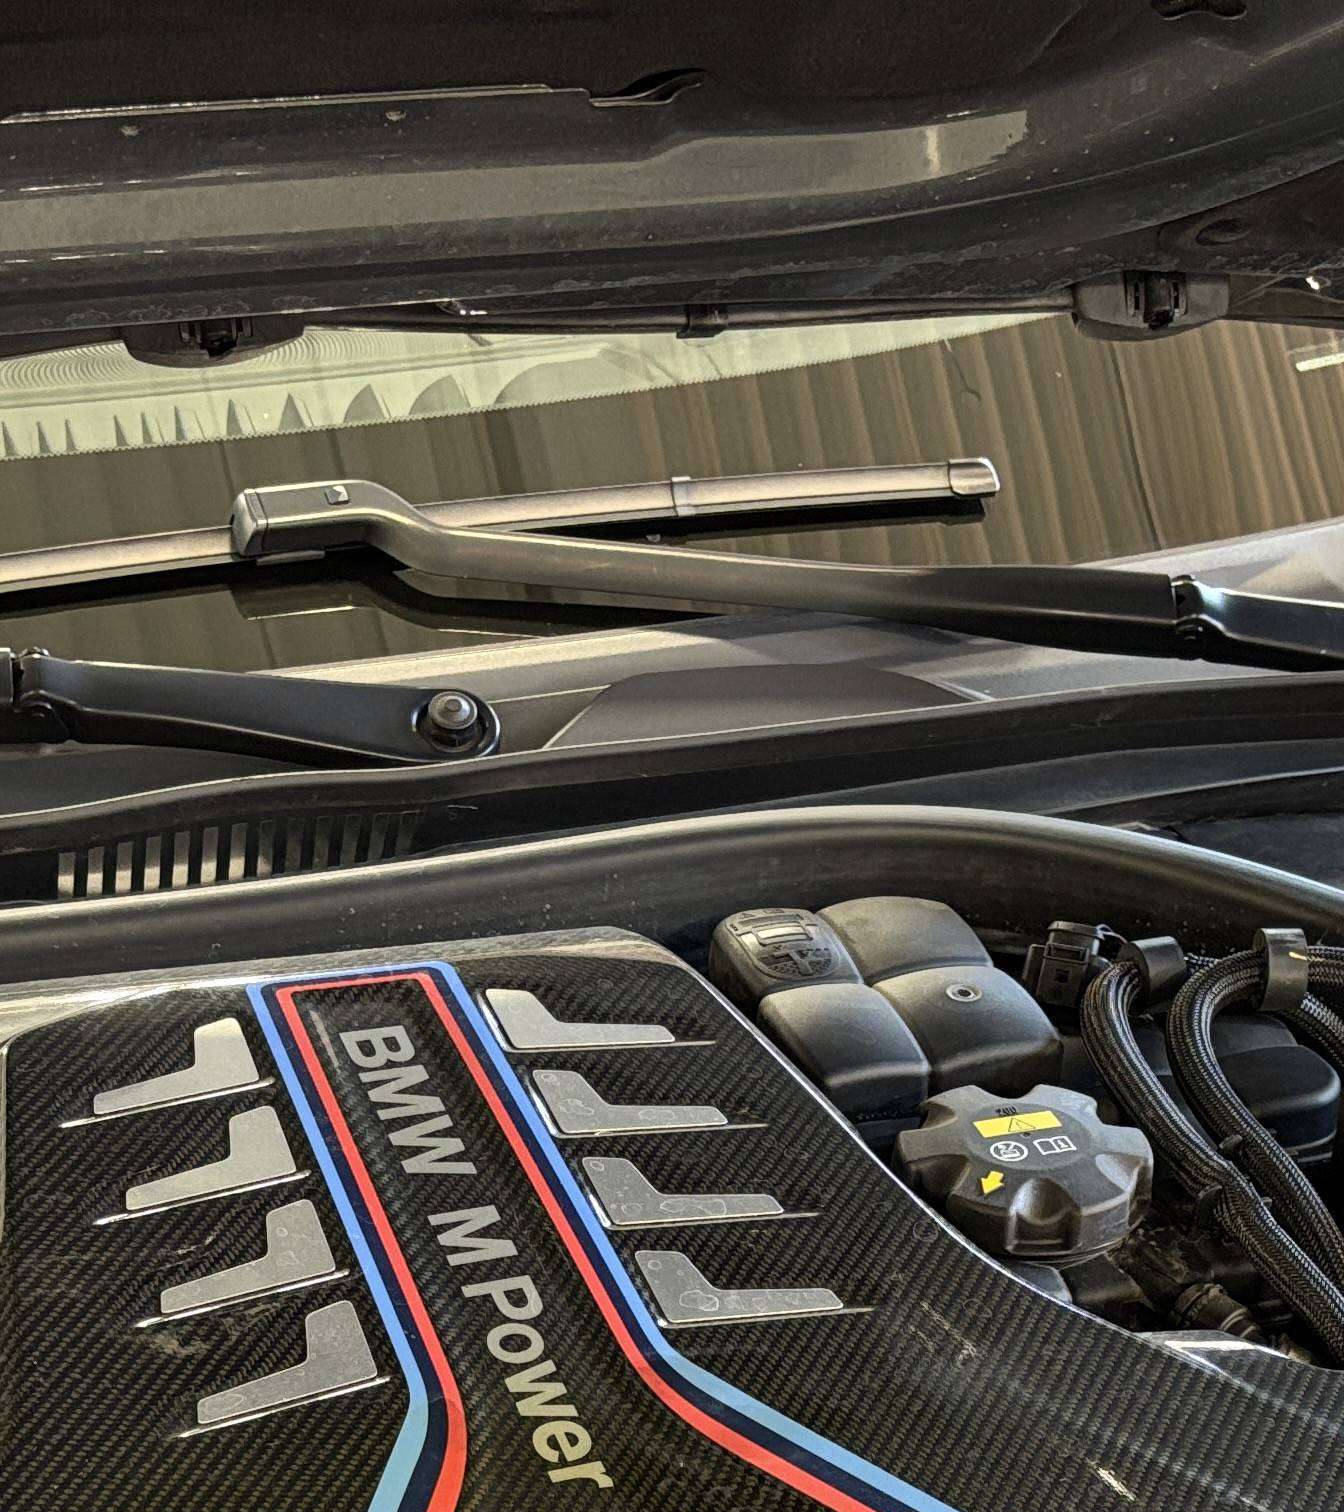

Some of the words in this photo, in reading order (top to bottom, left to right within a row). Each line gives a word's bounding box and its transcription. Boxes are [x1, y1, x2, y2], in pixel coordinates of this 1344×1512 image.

[339, 1025, 477, 1174] BMW
[427, 1204, 518, 1267] M
[461, 1275, 614, 1488] Power
